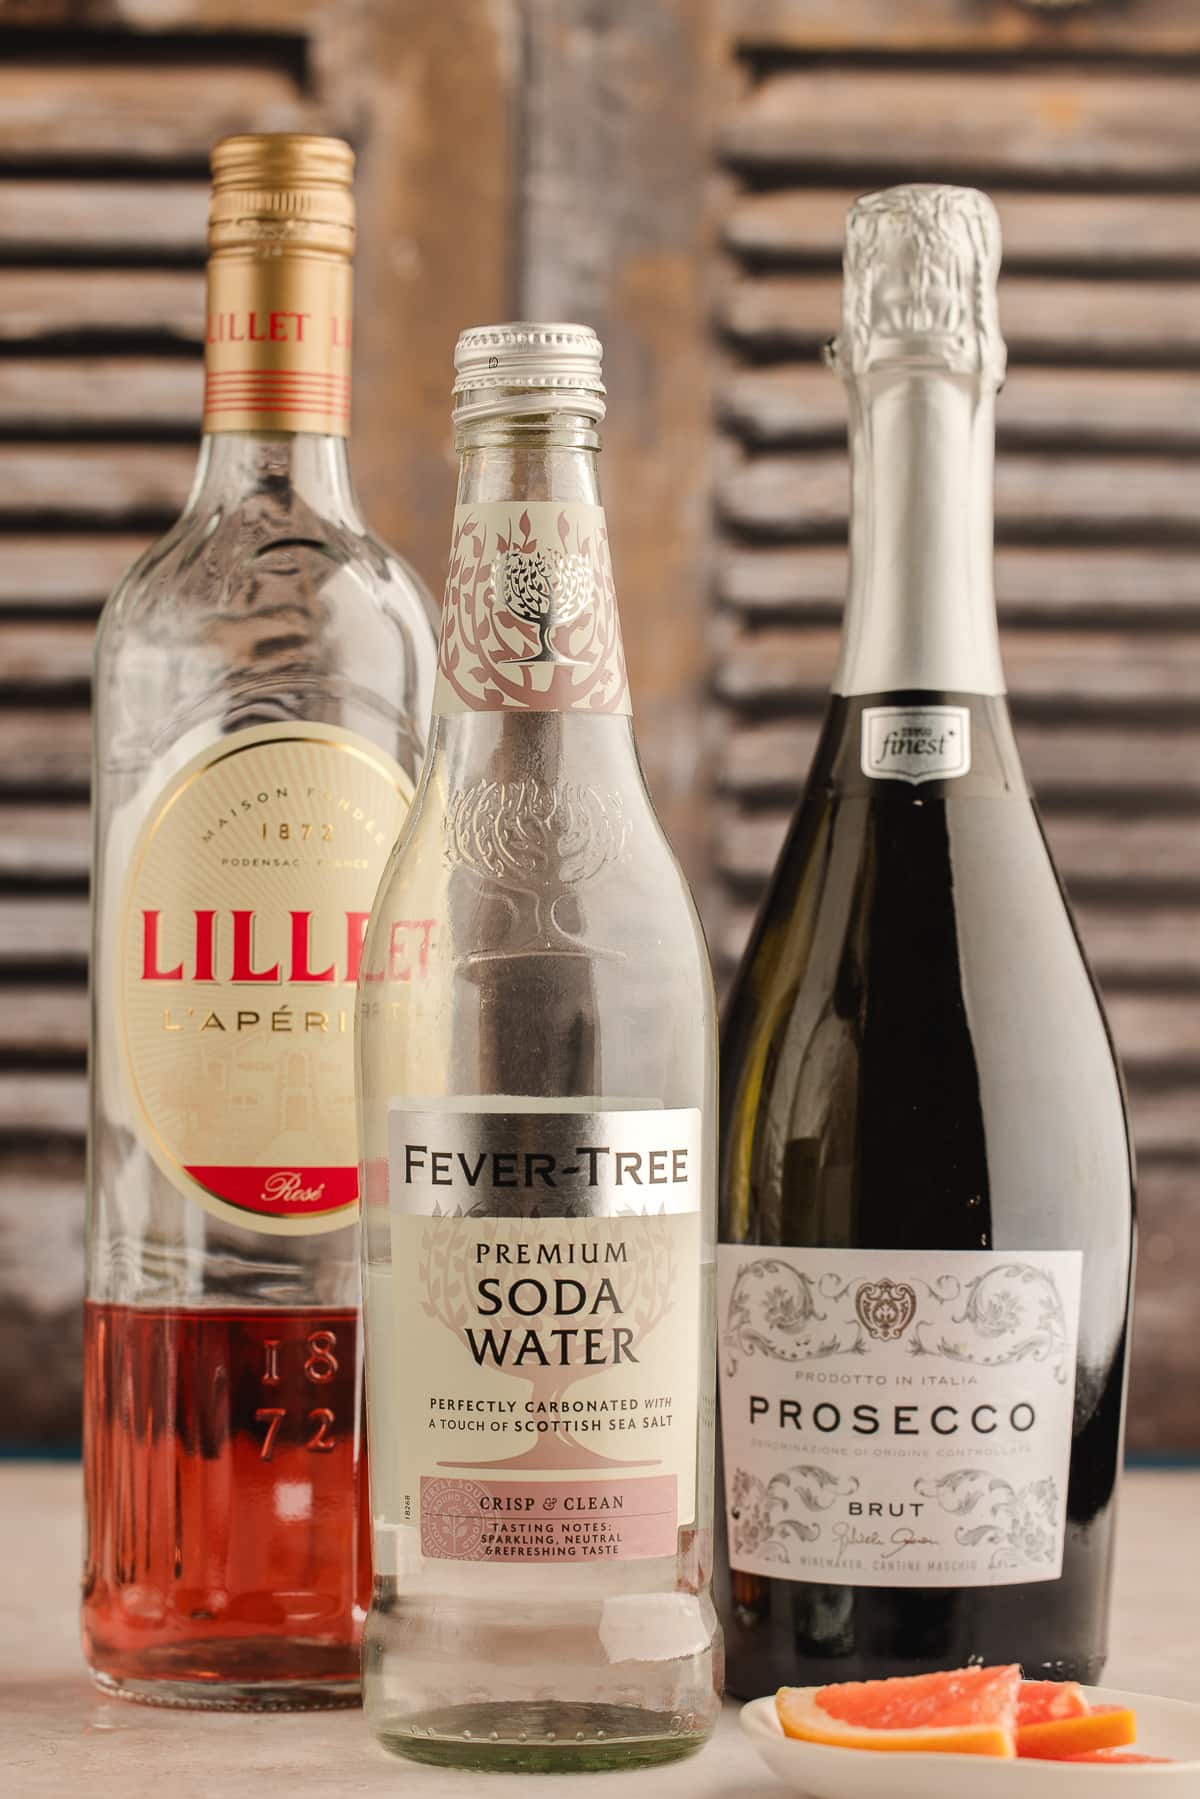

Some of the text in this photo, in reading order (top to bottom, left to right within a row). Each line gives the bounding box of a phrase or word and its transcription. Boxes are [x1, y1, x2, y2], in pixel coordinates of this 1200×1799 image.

[875, 731, 945, 764] finest
[201, 788, 288, 843] MAISON
[262, 823, 335, 841] 1872
[405, 1144, 689, 1187] FEVER-TREE
[260, 1171, 326, 1202] Rosé
[476, 1241, 629, 1264] PREMIUM
[476, 1277, 625, 1316] SODA
[464, 1327, 641, 1367] WATER
[794, 1371, 978, 1386] PRODOTTO IN ITALIA
[430, 1397, 673, 1413] PERFECTLY CARBONATED WITH
[428, 1415, 673, 1433] A TOUCH OF SCOTTISH SEA SALT
[750, 1395, 1036, 1435] PROSECCO
[479, 1495, 624, 1512] CRISP & CLEAN
[848, 1501, 926, 1517] BRUT
[492, 1522, 613, 1533] TASTING NOTES:
[480, 1533, 623, 1545] SPARKLING, NEUTRAL
[582, 1545, 619, 1555] TASTE
